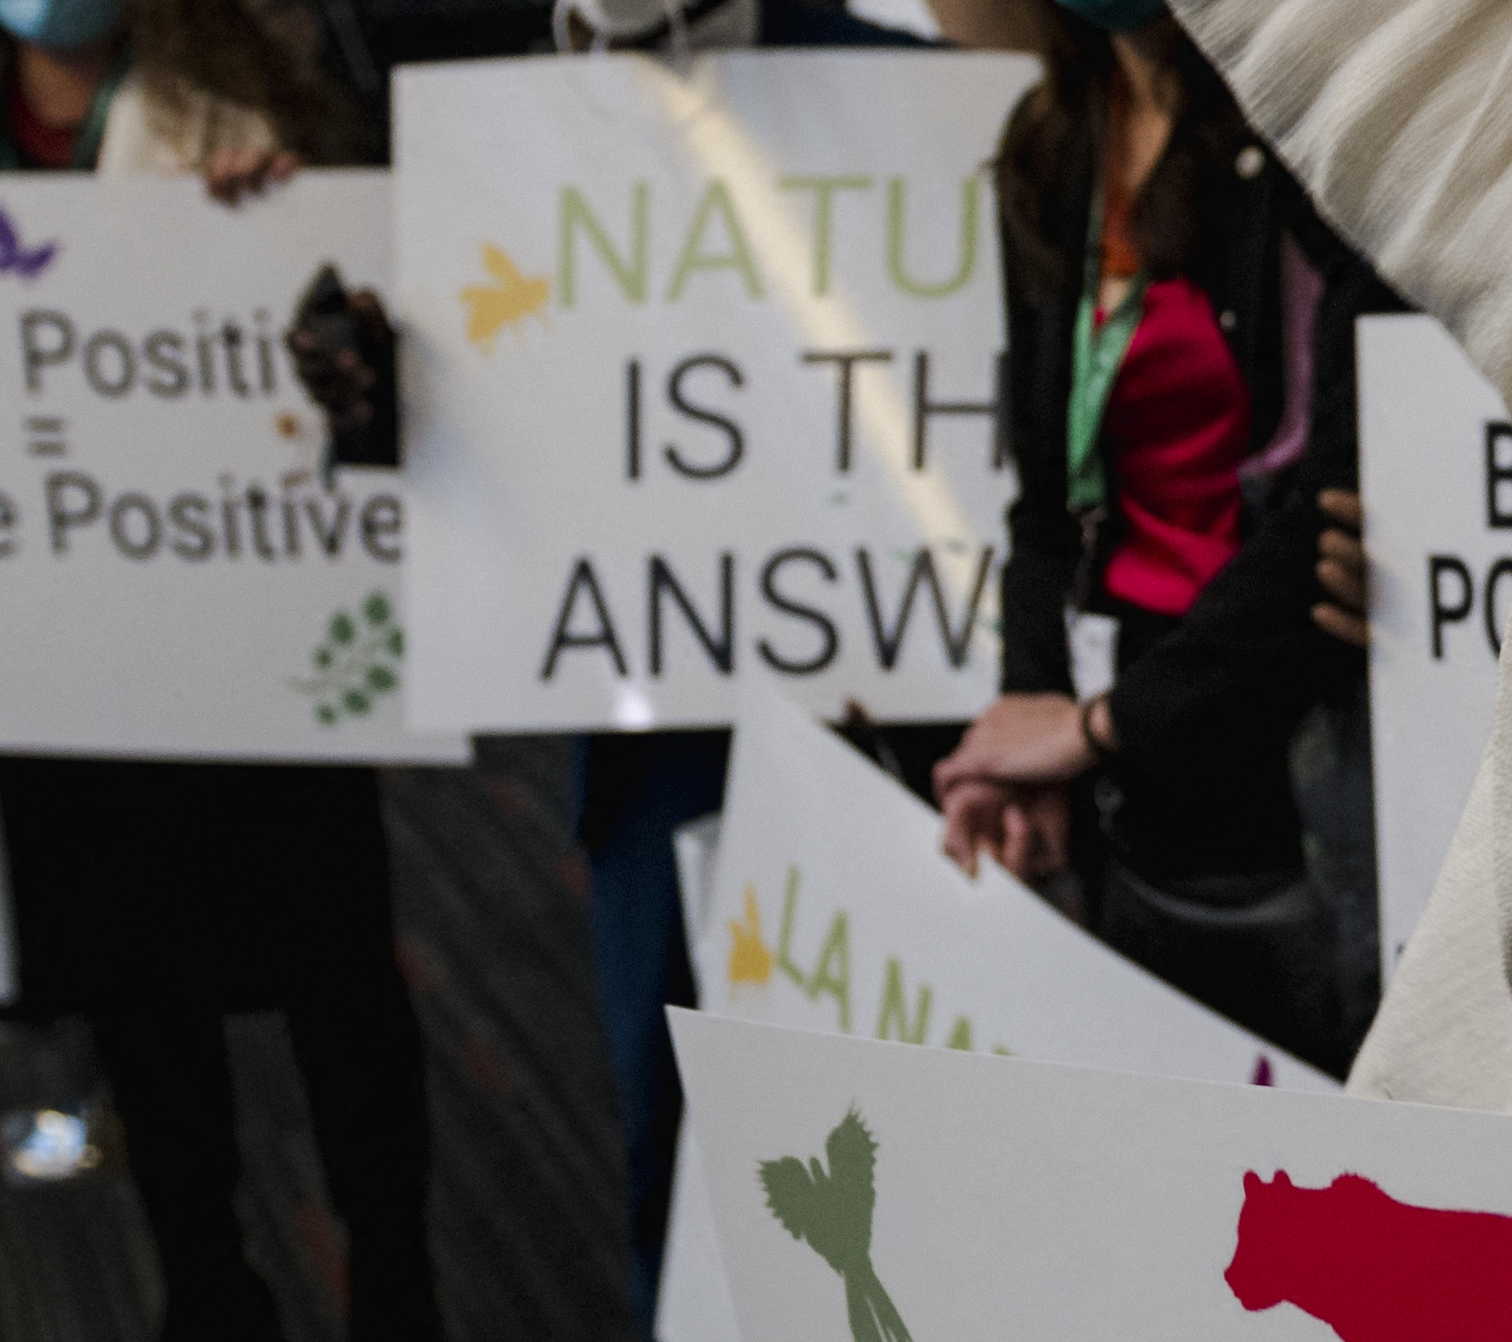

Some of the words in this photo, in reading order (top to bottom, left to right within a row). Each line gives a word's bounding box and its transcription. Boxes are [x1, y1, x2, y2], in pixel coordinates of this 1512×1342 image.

[557, 175, 981, 308] NATU
[20, 307, 295, 400] Positi
[26, 416, 66, 456] =
[625, 353, 747, 481] IS
[44, 471, 404, 567] Positive
[539, 545, 994, 684] ANSW
